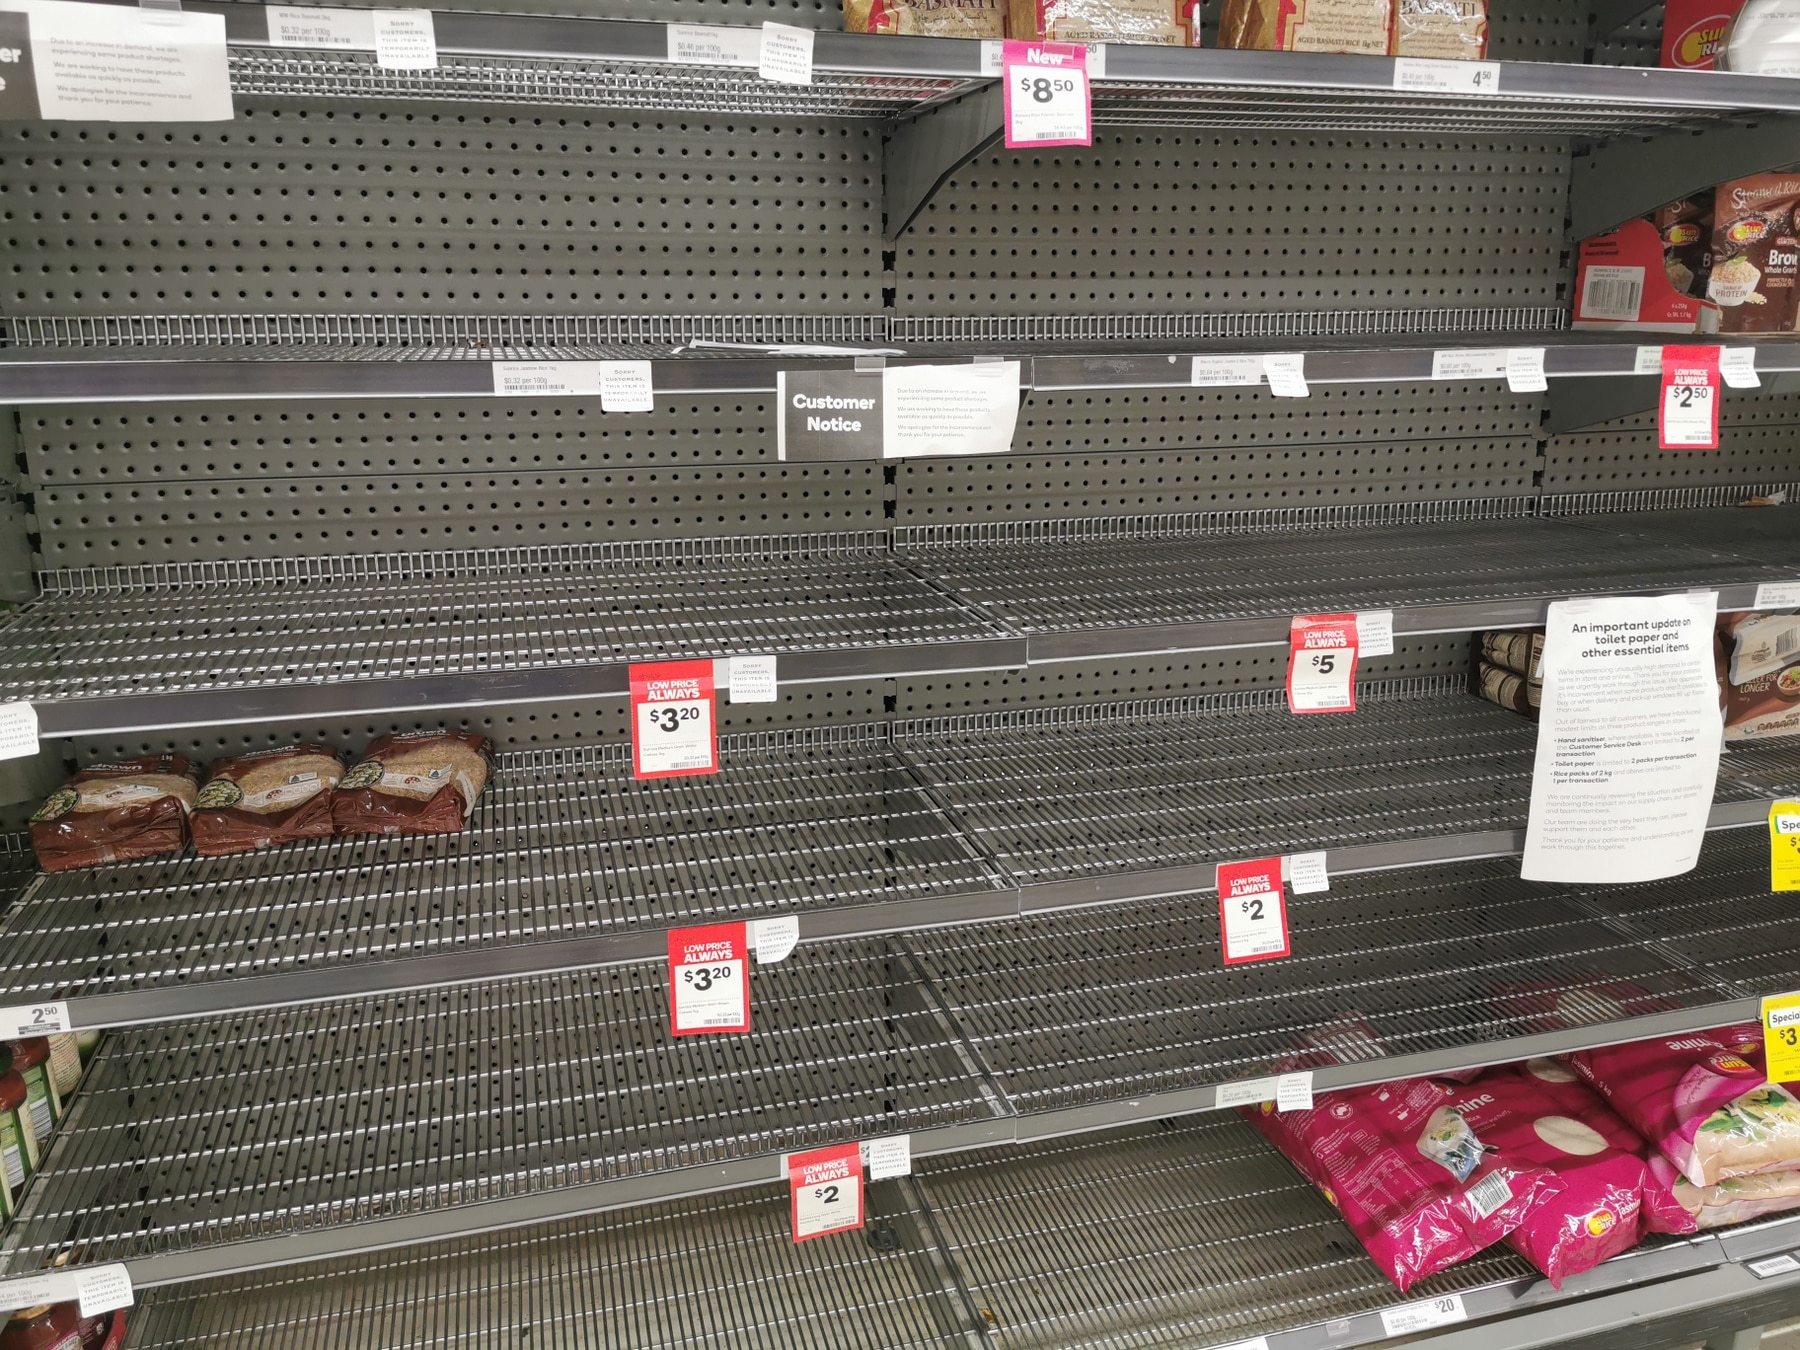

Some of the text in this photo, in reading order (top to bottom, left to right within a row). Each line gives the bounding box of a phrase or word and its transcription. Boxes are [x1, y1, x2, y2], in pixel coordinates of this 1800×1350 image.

[1317, 37, 1344, 46] BASMATI
[1027, 48, 1064, 64] New
[1716, 289, 1748, 298] PROTEIN
[1674, 376, 1708, 385] ALWAYS
[793, 394, 875, 410] Customer
[807, 417, 861, 431] Notice
[1572, 624, 1587, 632] An
[1589, 621, 1648, 633] important
[1651, 619, 1681, 630] update
[1304, 639, 1347, 648] ALWAYS
[1594, 632, 1678, 644] toilet paper and
[1581, 643, 1688, 657] other essential items
[1312, 654, 1335, 675] $5
[647, 680, 699, 690] LOW PRICE
[1740, 682, 1770, 694] LONGER
[648, 688, 700, 700] ALWAYS
[1230, 875, 1270, 887] LOW PRICE
[1231, 883, 1270, 896] ALWAYS
[1241, 899, 1264, 921] $2
[684, 941, 732, 953] LOW PRICE
[684, 950, 733, 963] ALWAYS
[1571, 1055, 1595, 1081] Jasmine
[803, 1160, 848, 1174] LOW PRICE
[805, 1168, 849, 1184] ALWAYS
[815, 1185, 839, 1204] $2
[1434, 1299, 1454, 1313] $20
